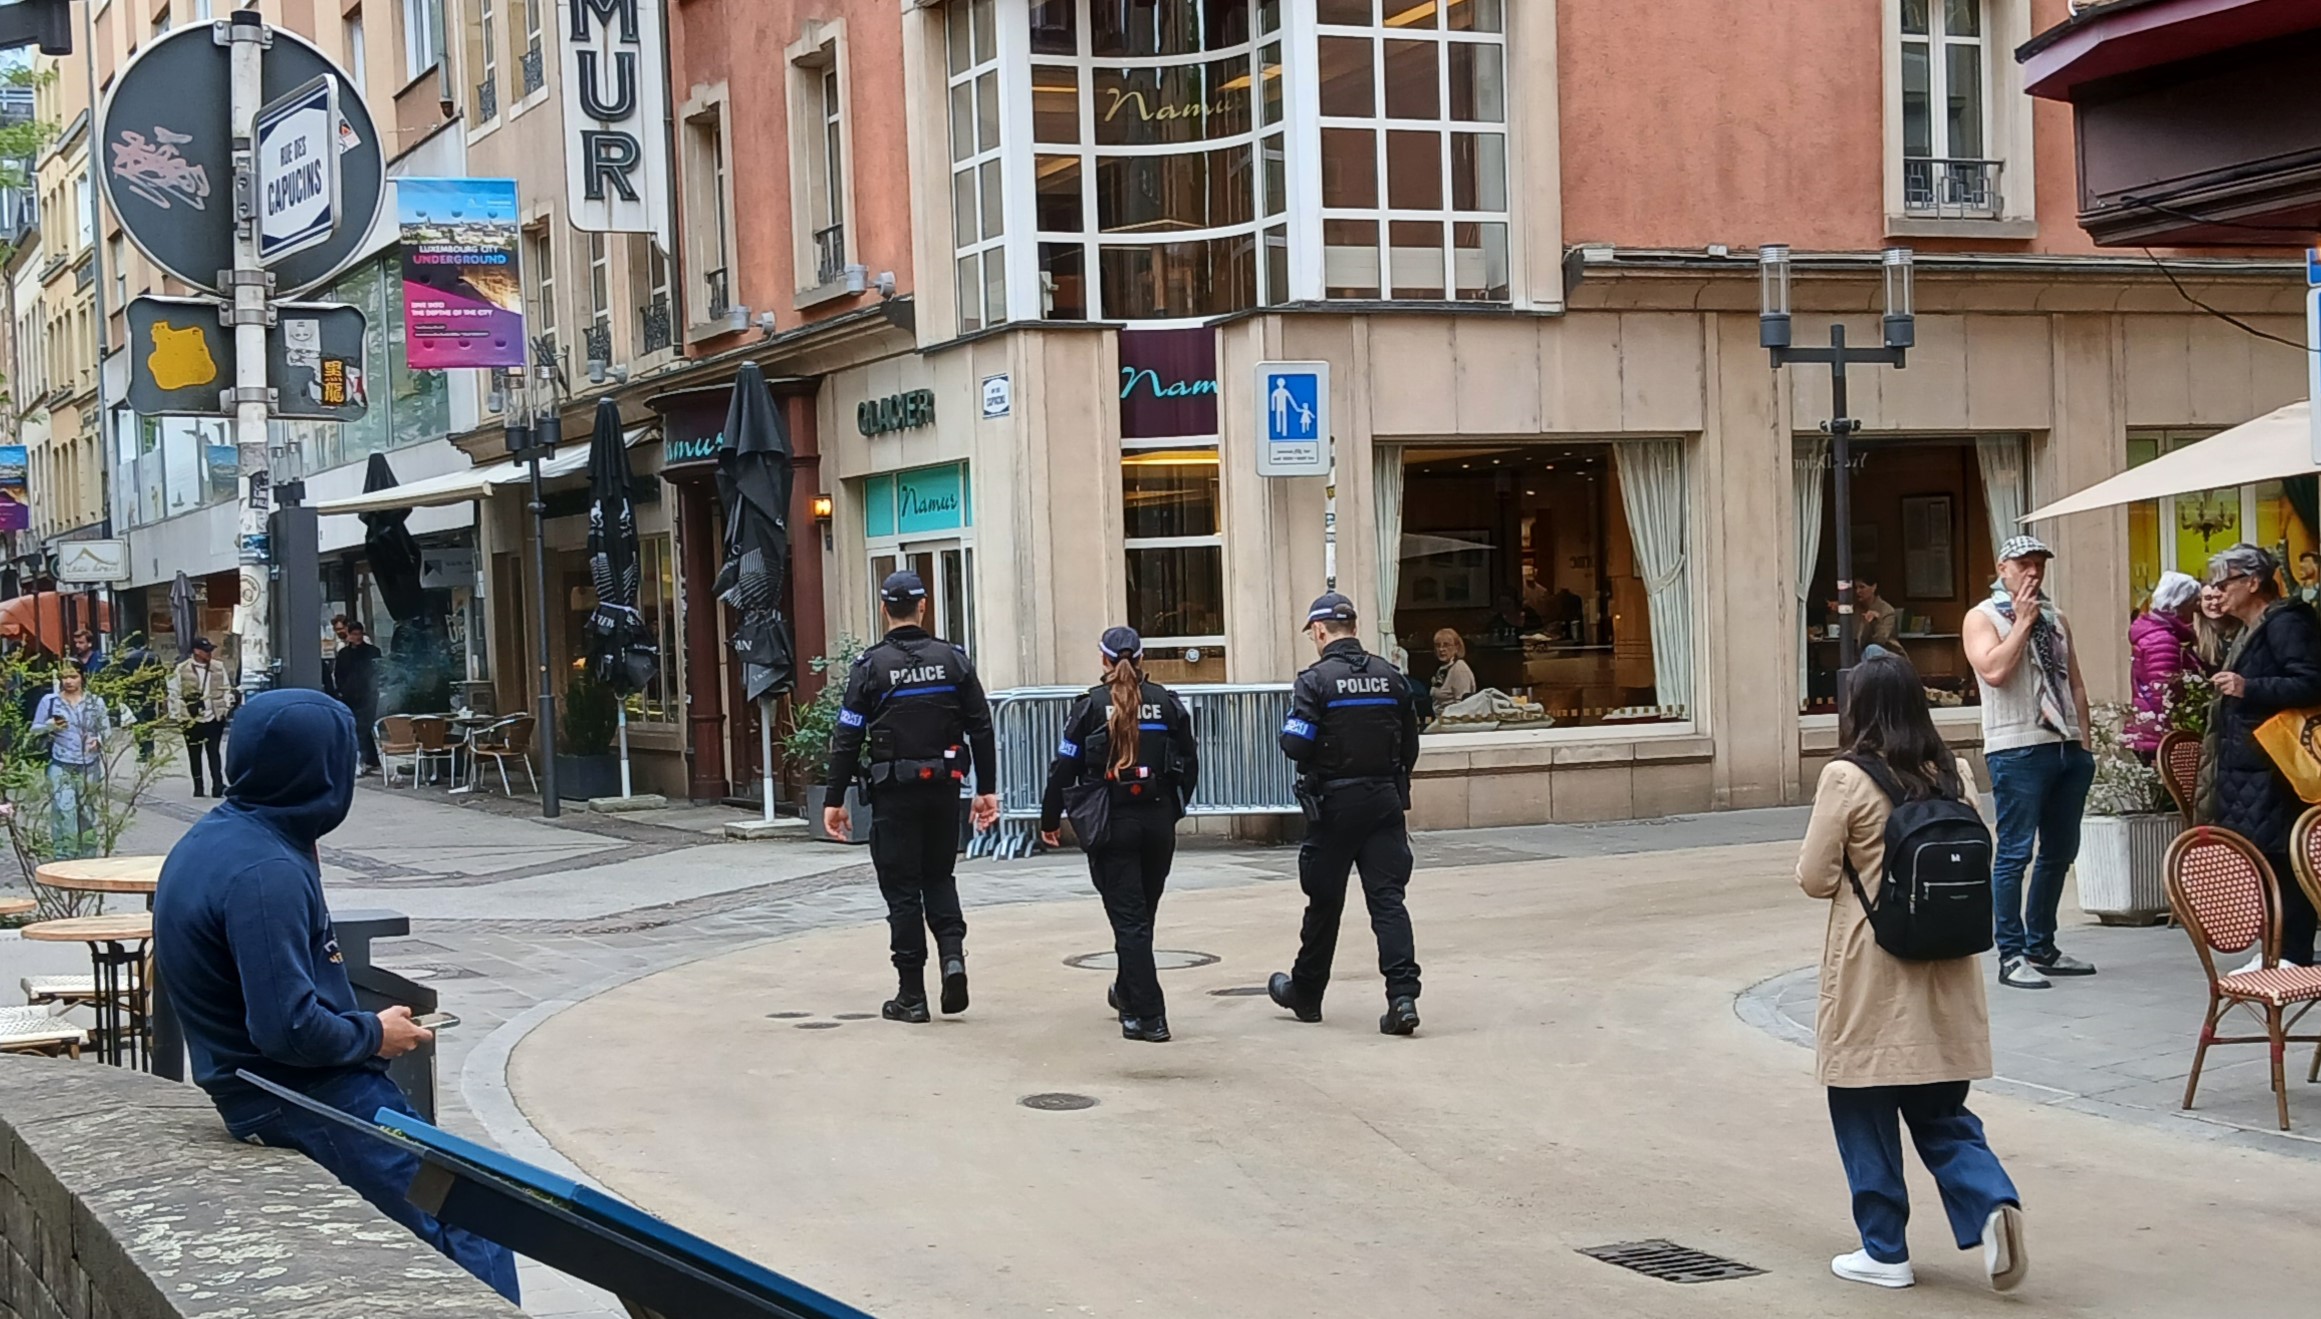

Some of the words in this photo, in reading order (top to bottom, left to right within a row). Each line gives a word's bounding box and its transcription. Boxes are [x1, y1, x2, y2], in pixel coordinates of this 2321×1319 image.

[280, 142, 293, 167] RUE
[294, 135, 307, 158] DES
[267, 158, 322, 216] CAPUCINS
[413, 254, 507, 264] UNDERGROUND
[419, 245, 478, 253] LUXEMBOURG
[480, 245, 499, 253] CITY
[857, 388, 935, 438] GLACIER
[901, 485, 958, 518] Namur
[889, 665, 946, 686] POLICE
[1336, 677, 1390, 694] POLICE
[1105, 704, 1162, 720] PICE
